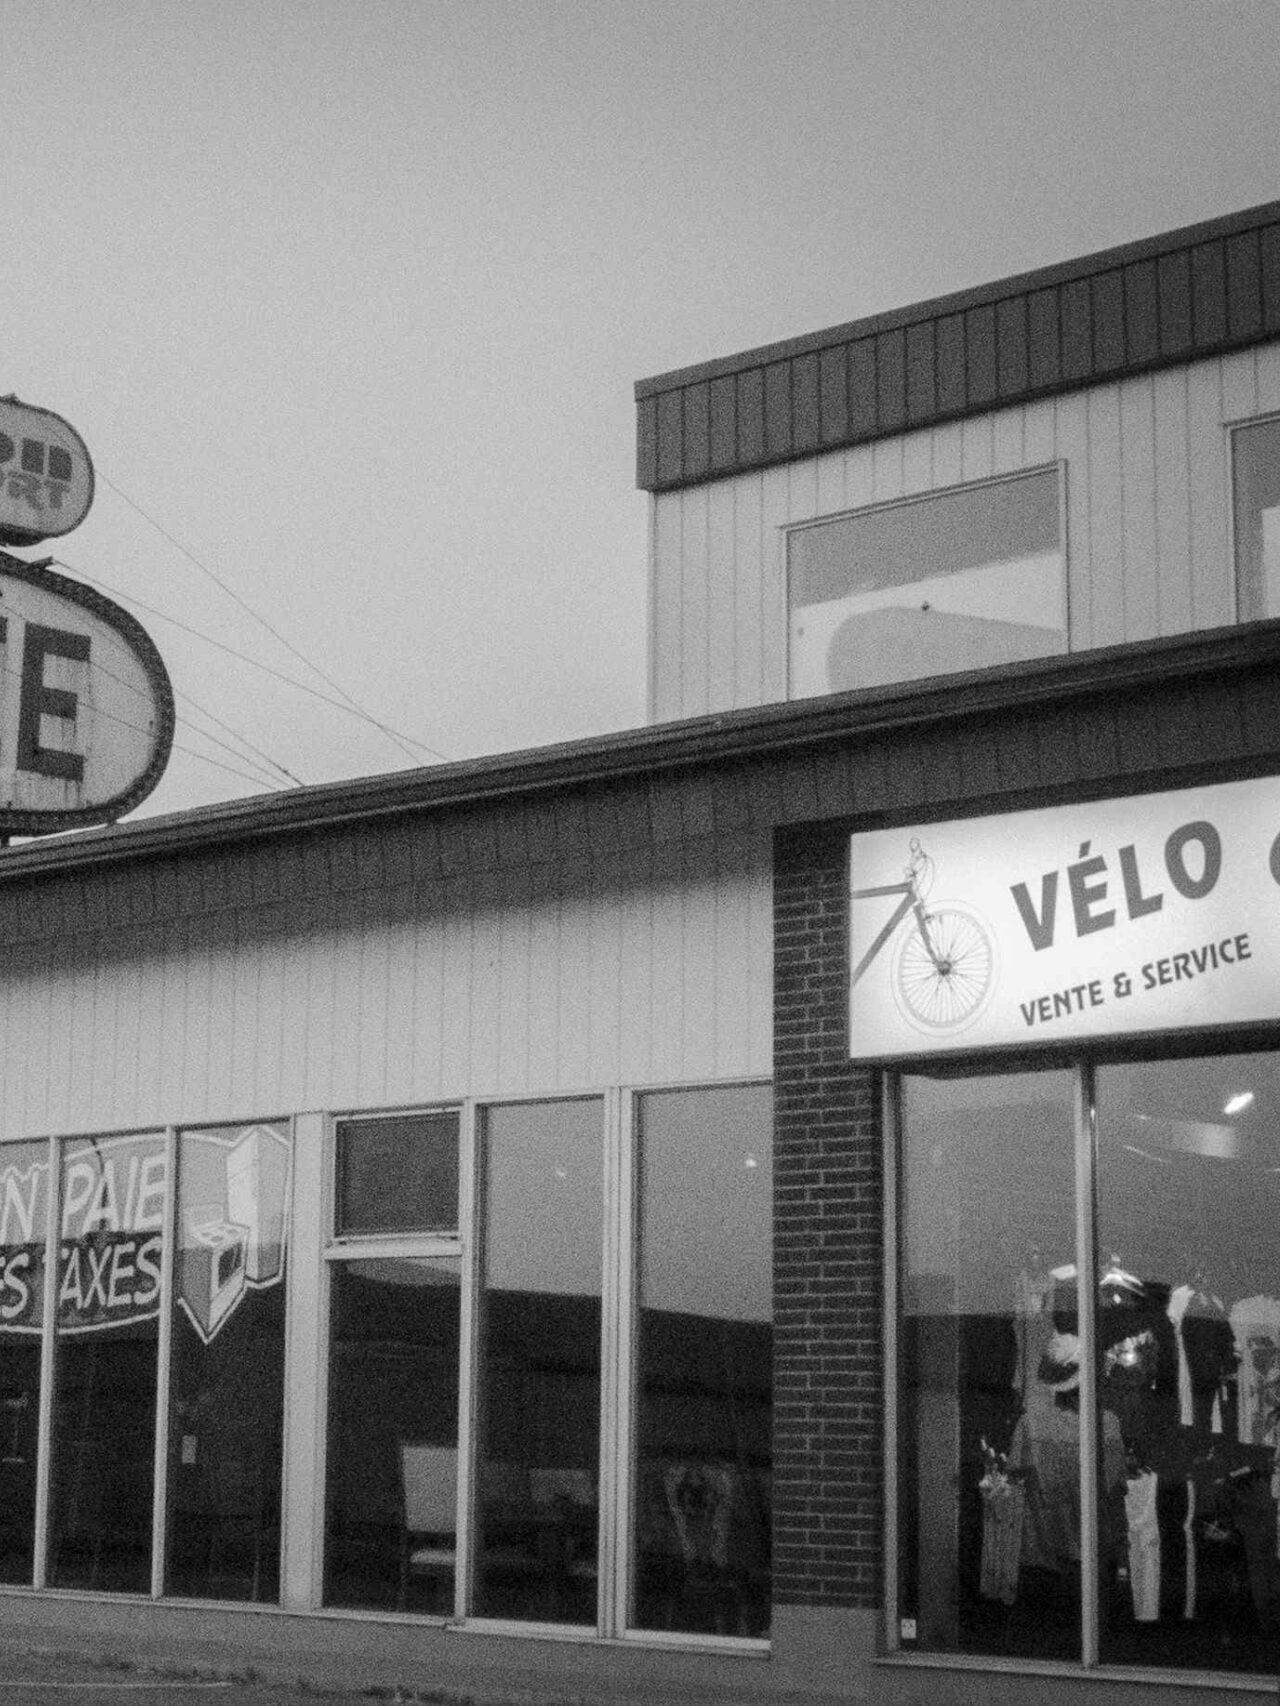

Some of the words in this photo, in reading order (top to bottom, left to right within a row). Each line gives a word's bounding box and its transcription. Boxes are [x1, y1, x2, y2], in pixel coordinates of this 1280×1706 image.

[1009, 820, 1222, 953] VÉLO
[1019, 979, 1105, 1027] VENTE
[1112, 971, 1132, 999] &
[1141, 932, 1253, 991] SERVICE
[61, 1154, 165, 1241] PAIE
[43, 1235, 161, 1309] AXES
